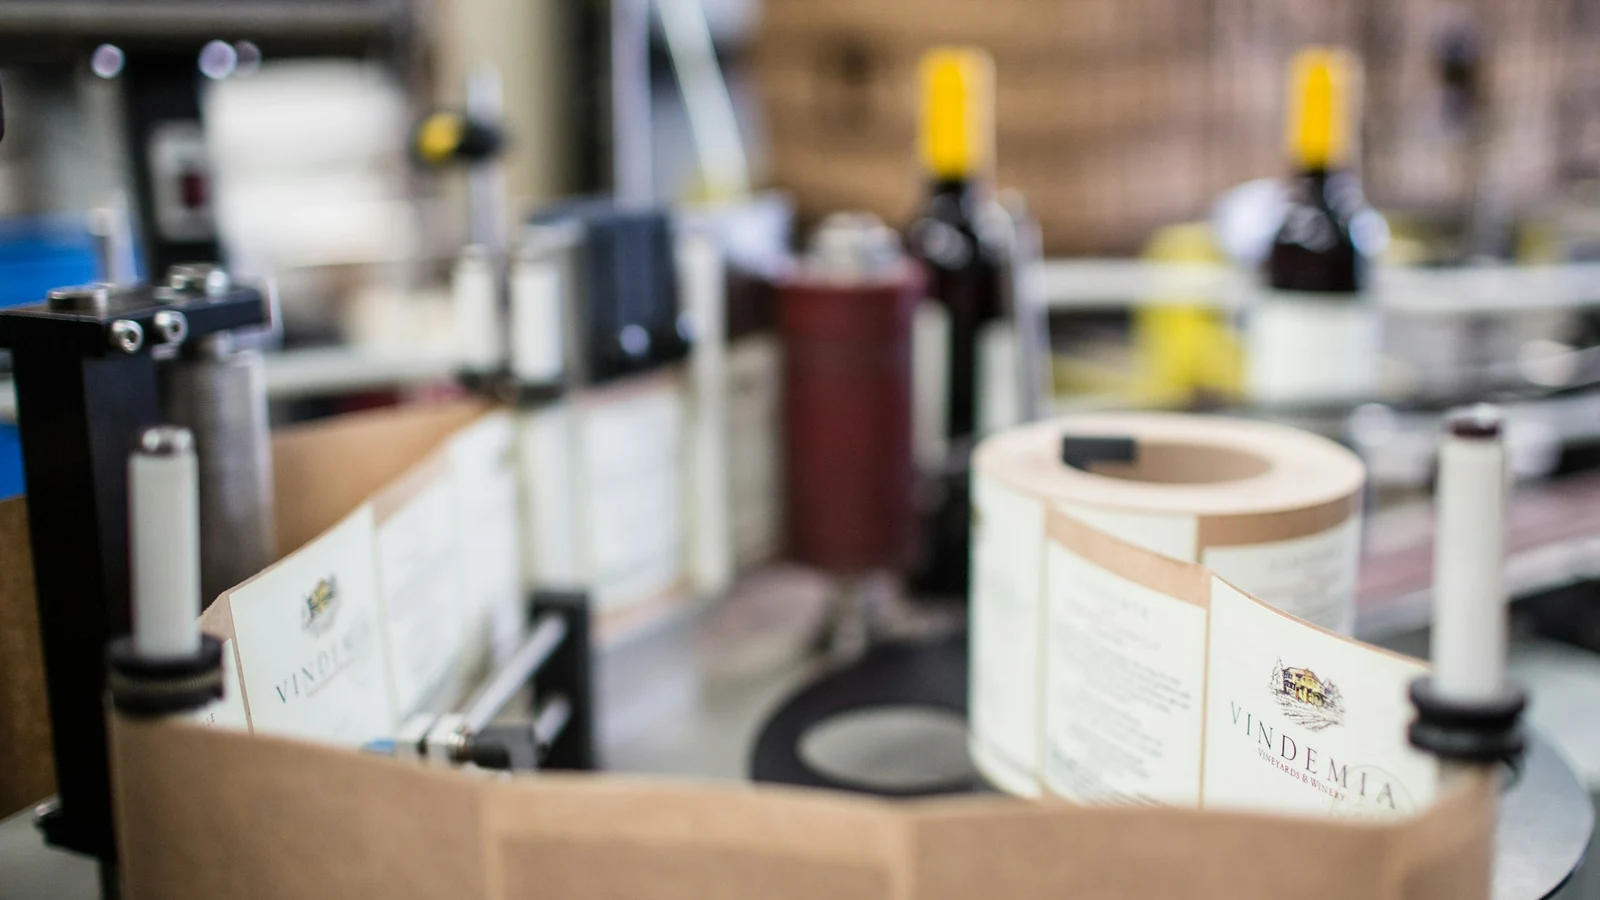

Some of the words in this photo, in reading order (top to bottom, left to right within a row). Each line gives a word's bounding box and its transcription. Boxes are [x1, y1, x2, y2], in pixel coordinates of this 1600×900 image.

[1230, 700, 1396, 809] VINDEMIA
[1257, 747, 1300, 780] VINEYARDS
[1301, 773, 1309, 783] &
[1309, 776, 1346, 802] WINERY
